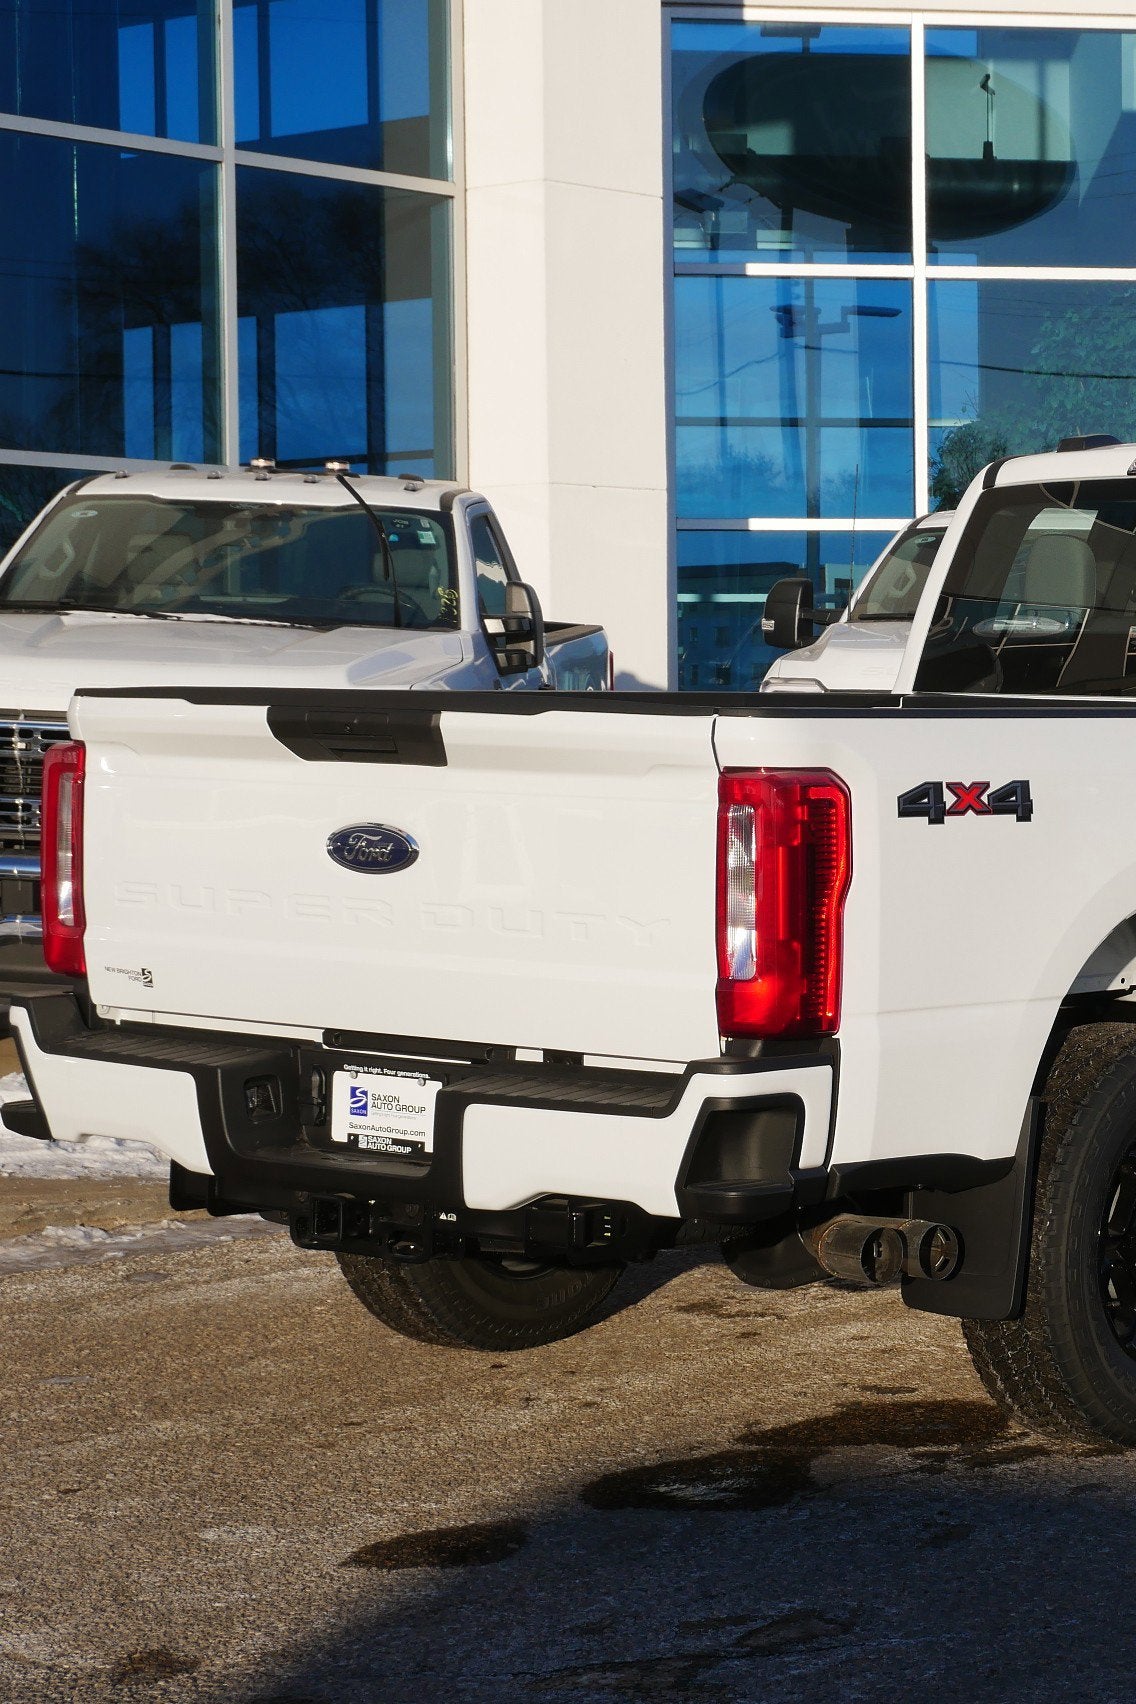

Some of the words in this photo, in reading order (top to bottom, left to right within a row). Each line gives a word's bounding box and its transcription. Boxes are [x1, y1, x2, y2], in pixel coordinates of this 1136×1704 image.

[344, 833, 394, 862] Ford
[113, 879, 396, 929] SUPER
[420, 900, 672, 947] DUTY
[343, 1064, 364, 1072] Getting
[369, 1066, 383, 1075] right.
[383, 1068, 396, 1076] Four
[397, 1070, 431, 1079] generations.
[371, 1093, 400, 1104] SAXON
[371, 1102, 393, 1111] AUTO
[395, 1104, 426, 1114] GROUP
[348, 1121, 426, 1137] SaxonAutoGroup.com
[367, 1136, 392, 1144] SAXON
[367, 1143, 387, 1151] AUTO
[387, 1145, 412, 1154] GROUP
